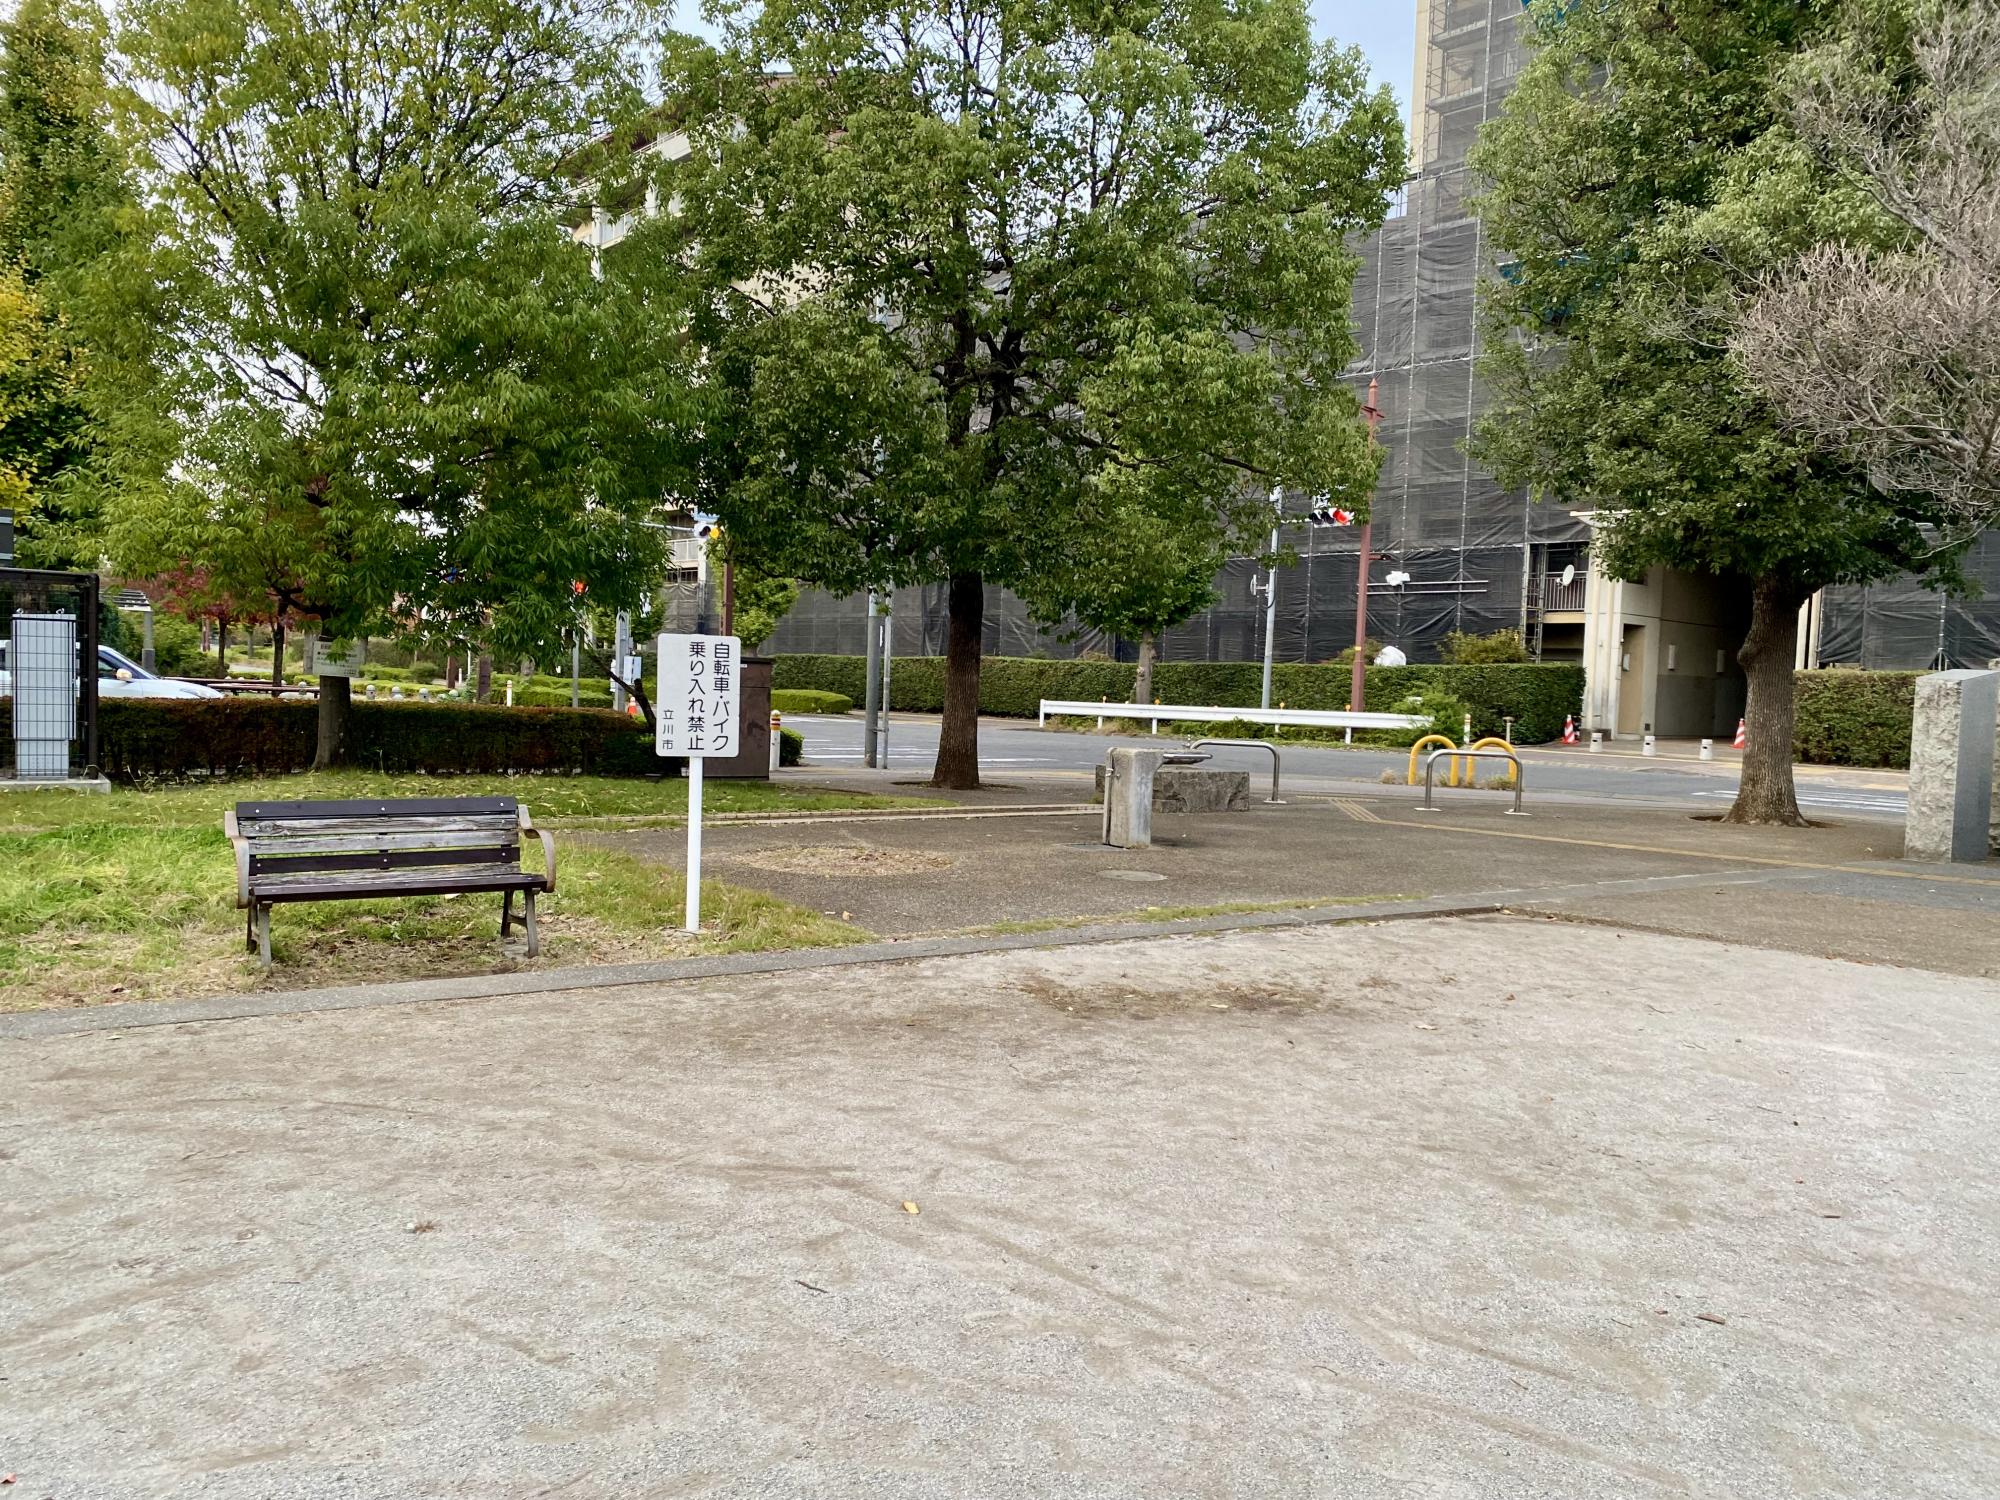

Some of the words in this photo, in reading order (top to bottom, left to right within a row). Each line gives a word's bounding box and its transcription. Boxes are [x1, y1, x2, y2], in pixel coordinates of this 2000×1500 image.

[662, 709, 674, 750] 立川市
[687, 641, 706, 751] 乗り入れ禁止
[712, 642, 730, 751] 自転車・バイク
